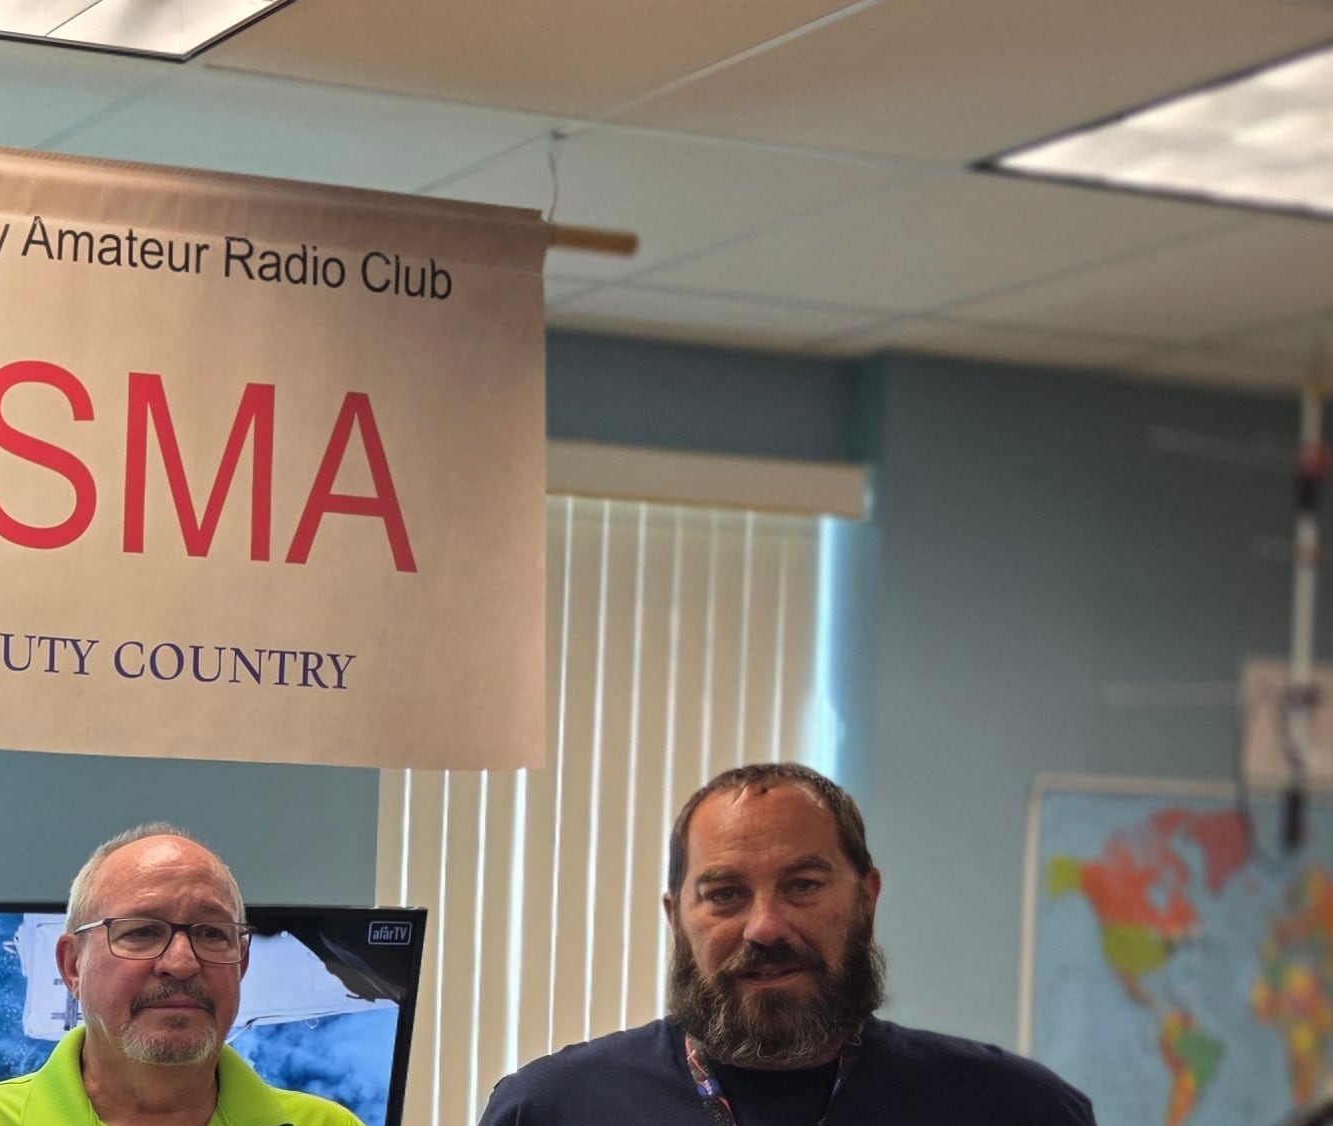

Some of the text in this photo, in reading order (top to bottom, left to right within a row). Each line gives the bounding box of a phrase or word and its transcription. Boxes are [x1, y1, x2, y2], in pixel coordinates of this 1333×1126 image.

[20, 215, 210, 274] Amateur
[224, 236, 347, 288] Radio
[361, 251, 453, 300] Club
[114, 640, 357, 691] COUNTRY
